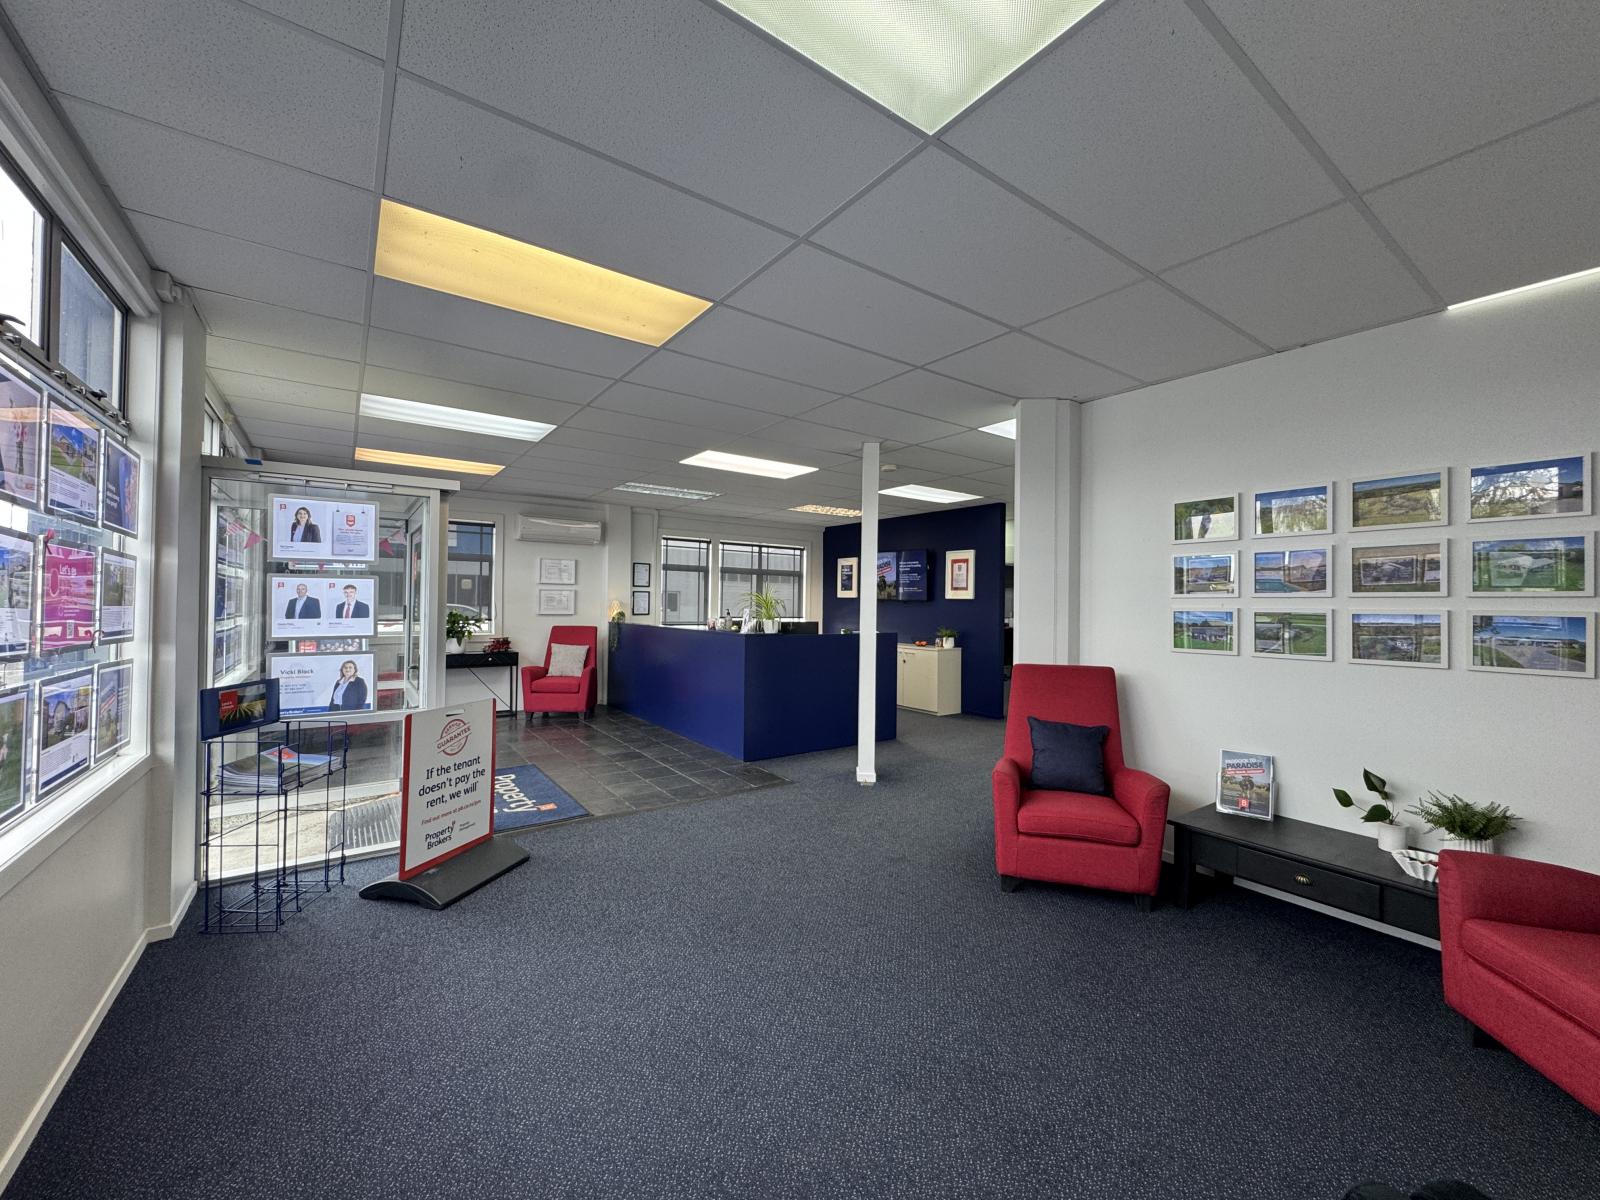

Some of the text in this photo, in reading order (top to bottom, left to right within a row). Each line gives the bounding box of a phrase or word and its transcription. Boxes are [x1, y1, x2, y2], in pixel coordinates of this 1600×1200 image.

[437, 727, 471, 749] GUARANTEE
[426, 756, 480, 780] If the tenant
[418, 768, 486, 797] doesn't pay the
[495, 774, 538, 812] Property
[426, 794, 447, 809] rent,
[449, 790, 462, 800] we
[425, 825, 454, 842] Property
[427, 834, 452, 850] Brokers
